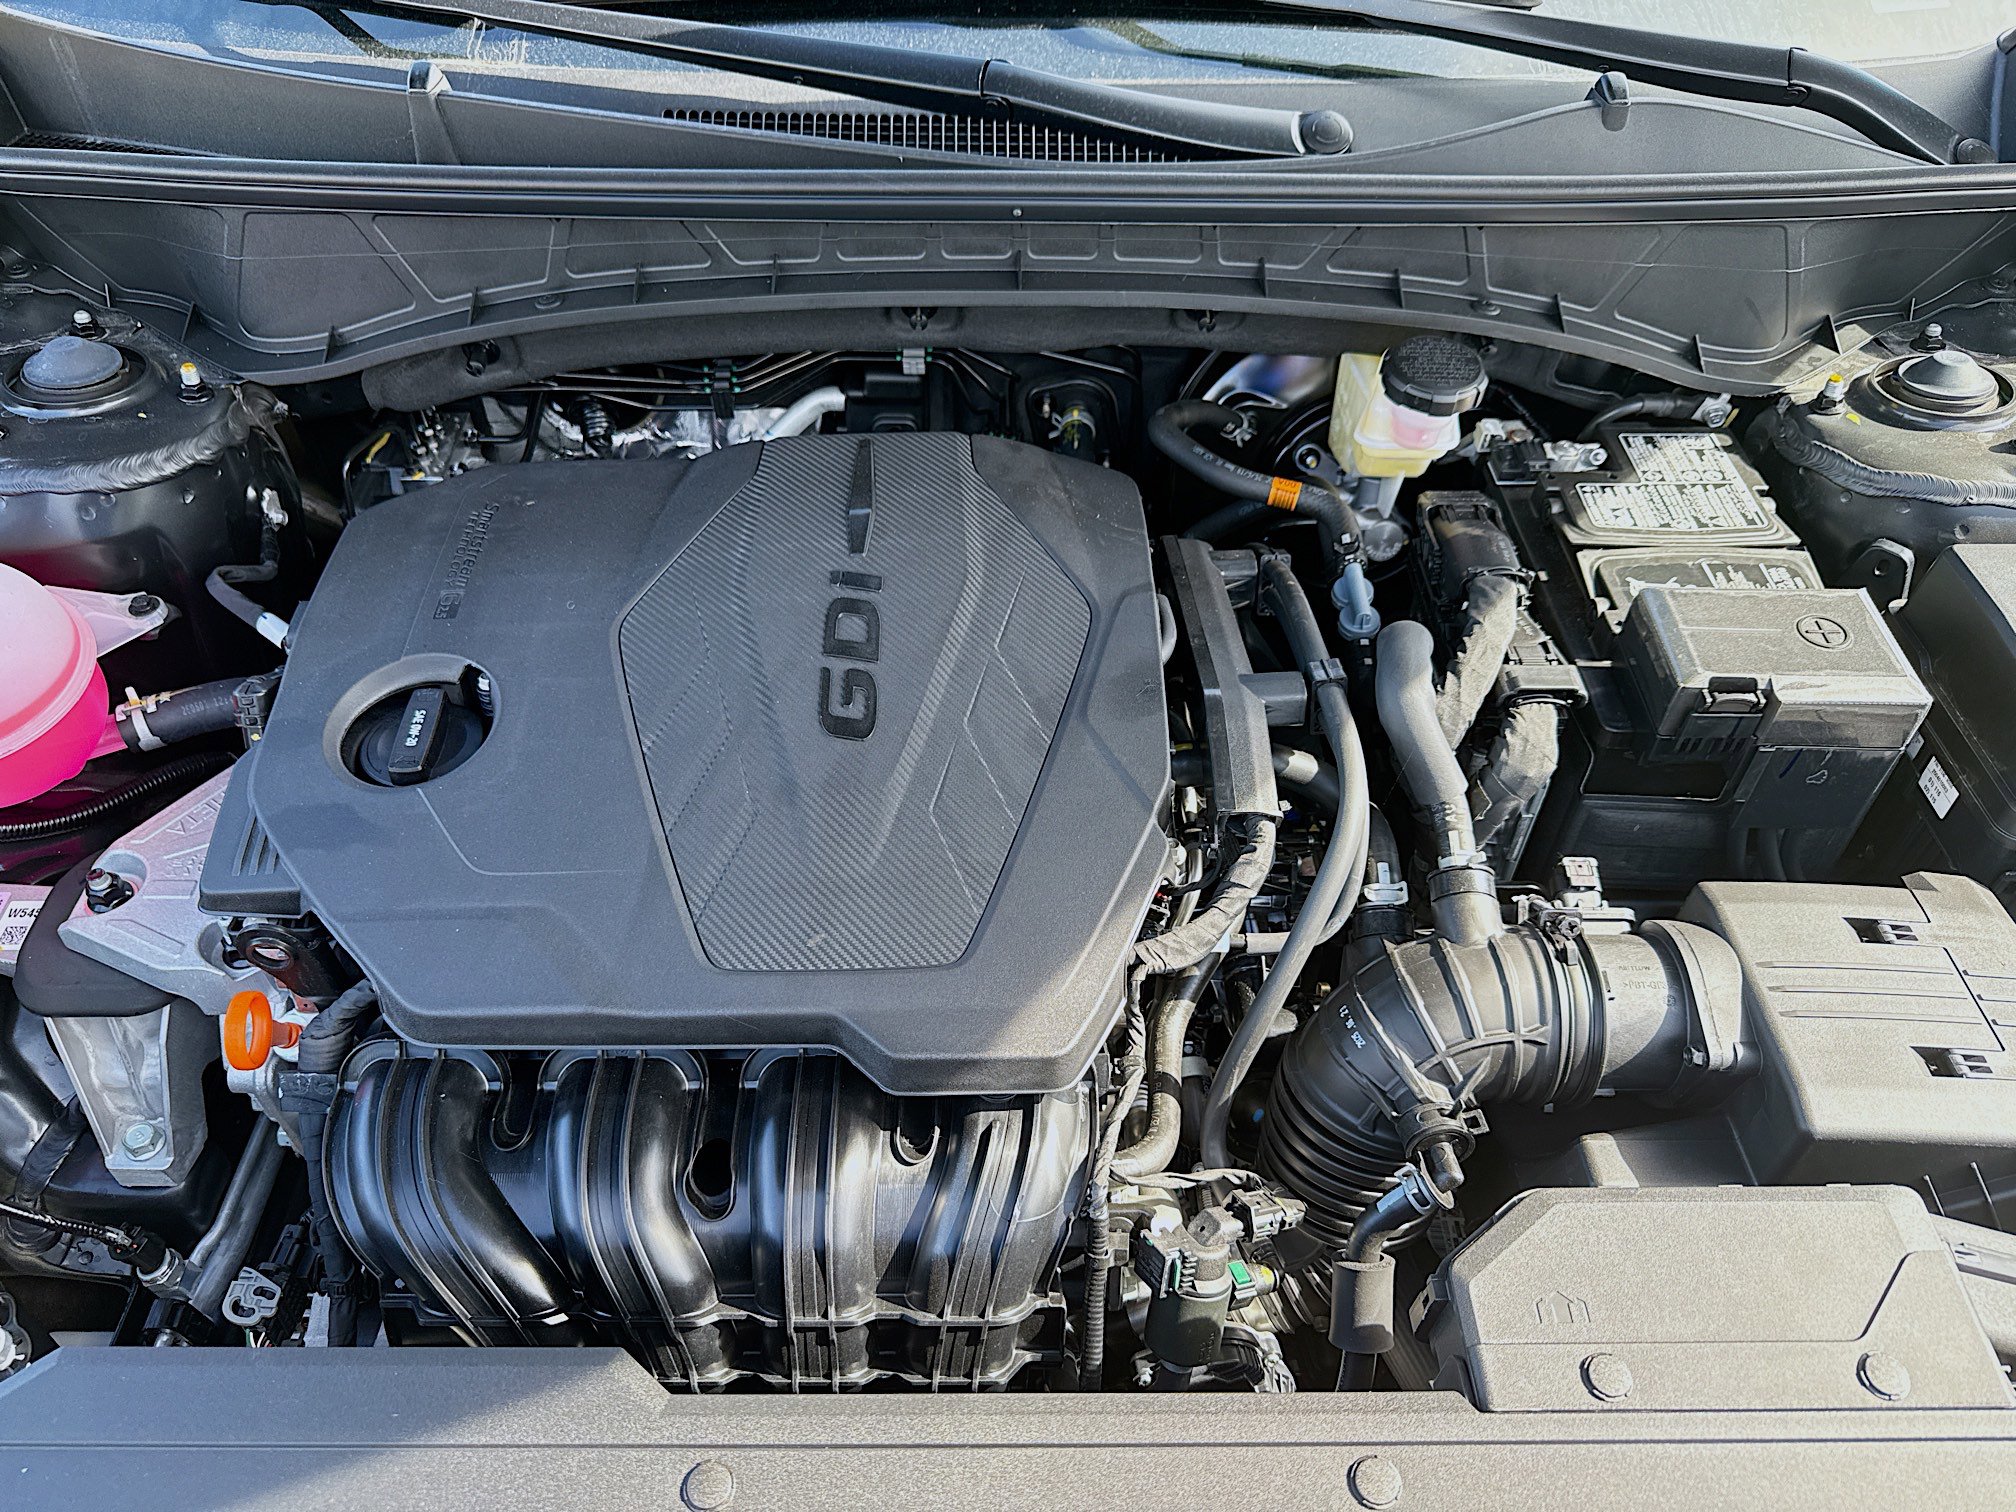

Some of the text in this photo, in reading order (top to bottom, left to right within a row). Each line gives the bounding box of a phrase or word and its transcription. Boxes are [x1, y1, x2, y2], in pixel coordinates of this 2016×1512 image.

[445, 511, 480, 587] TECHNOLOGY
[456, 502, 500, 587] Smartstream
[412, 709, 427, 724] SAE
